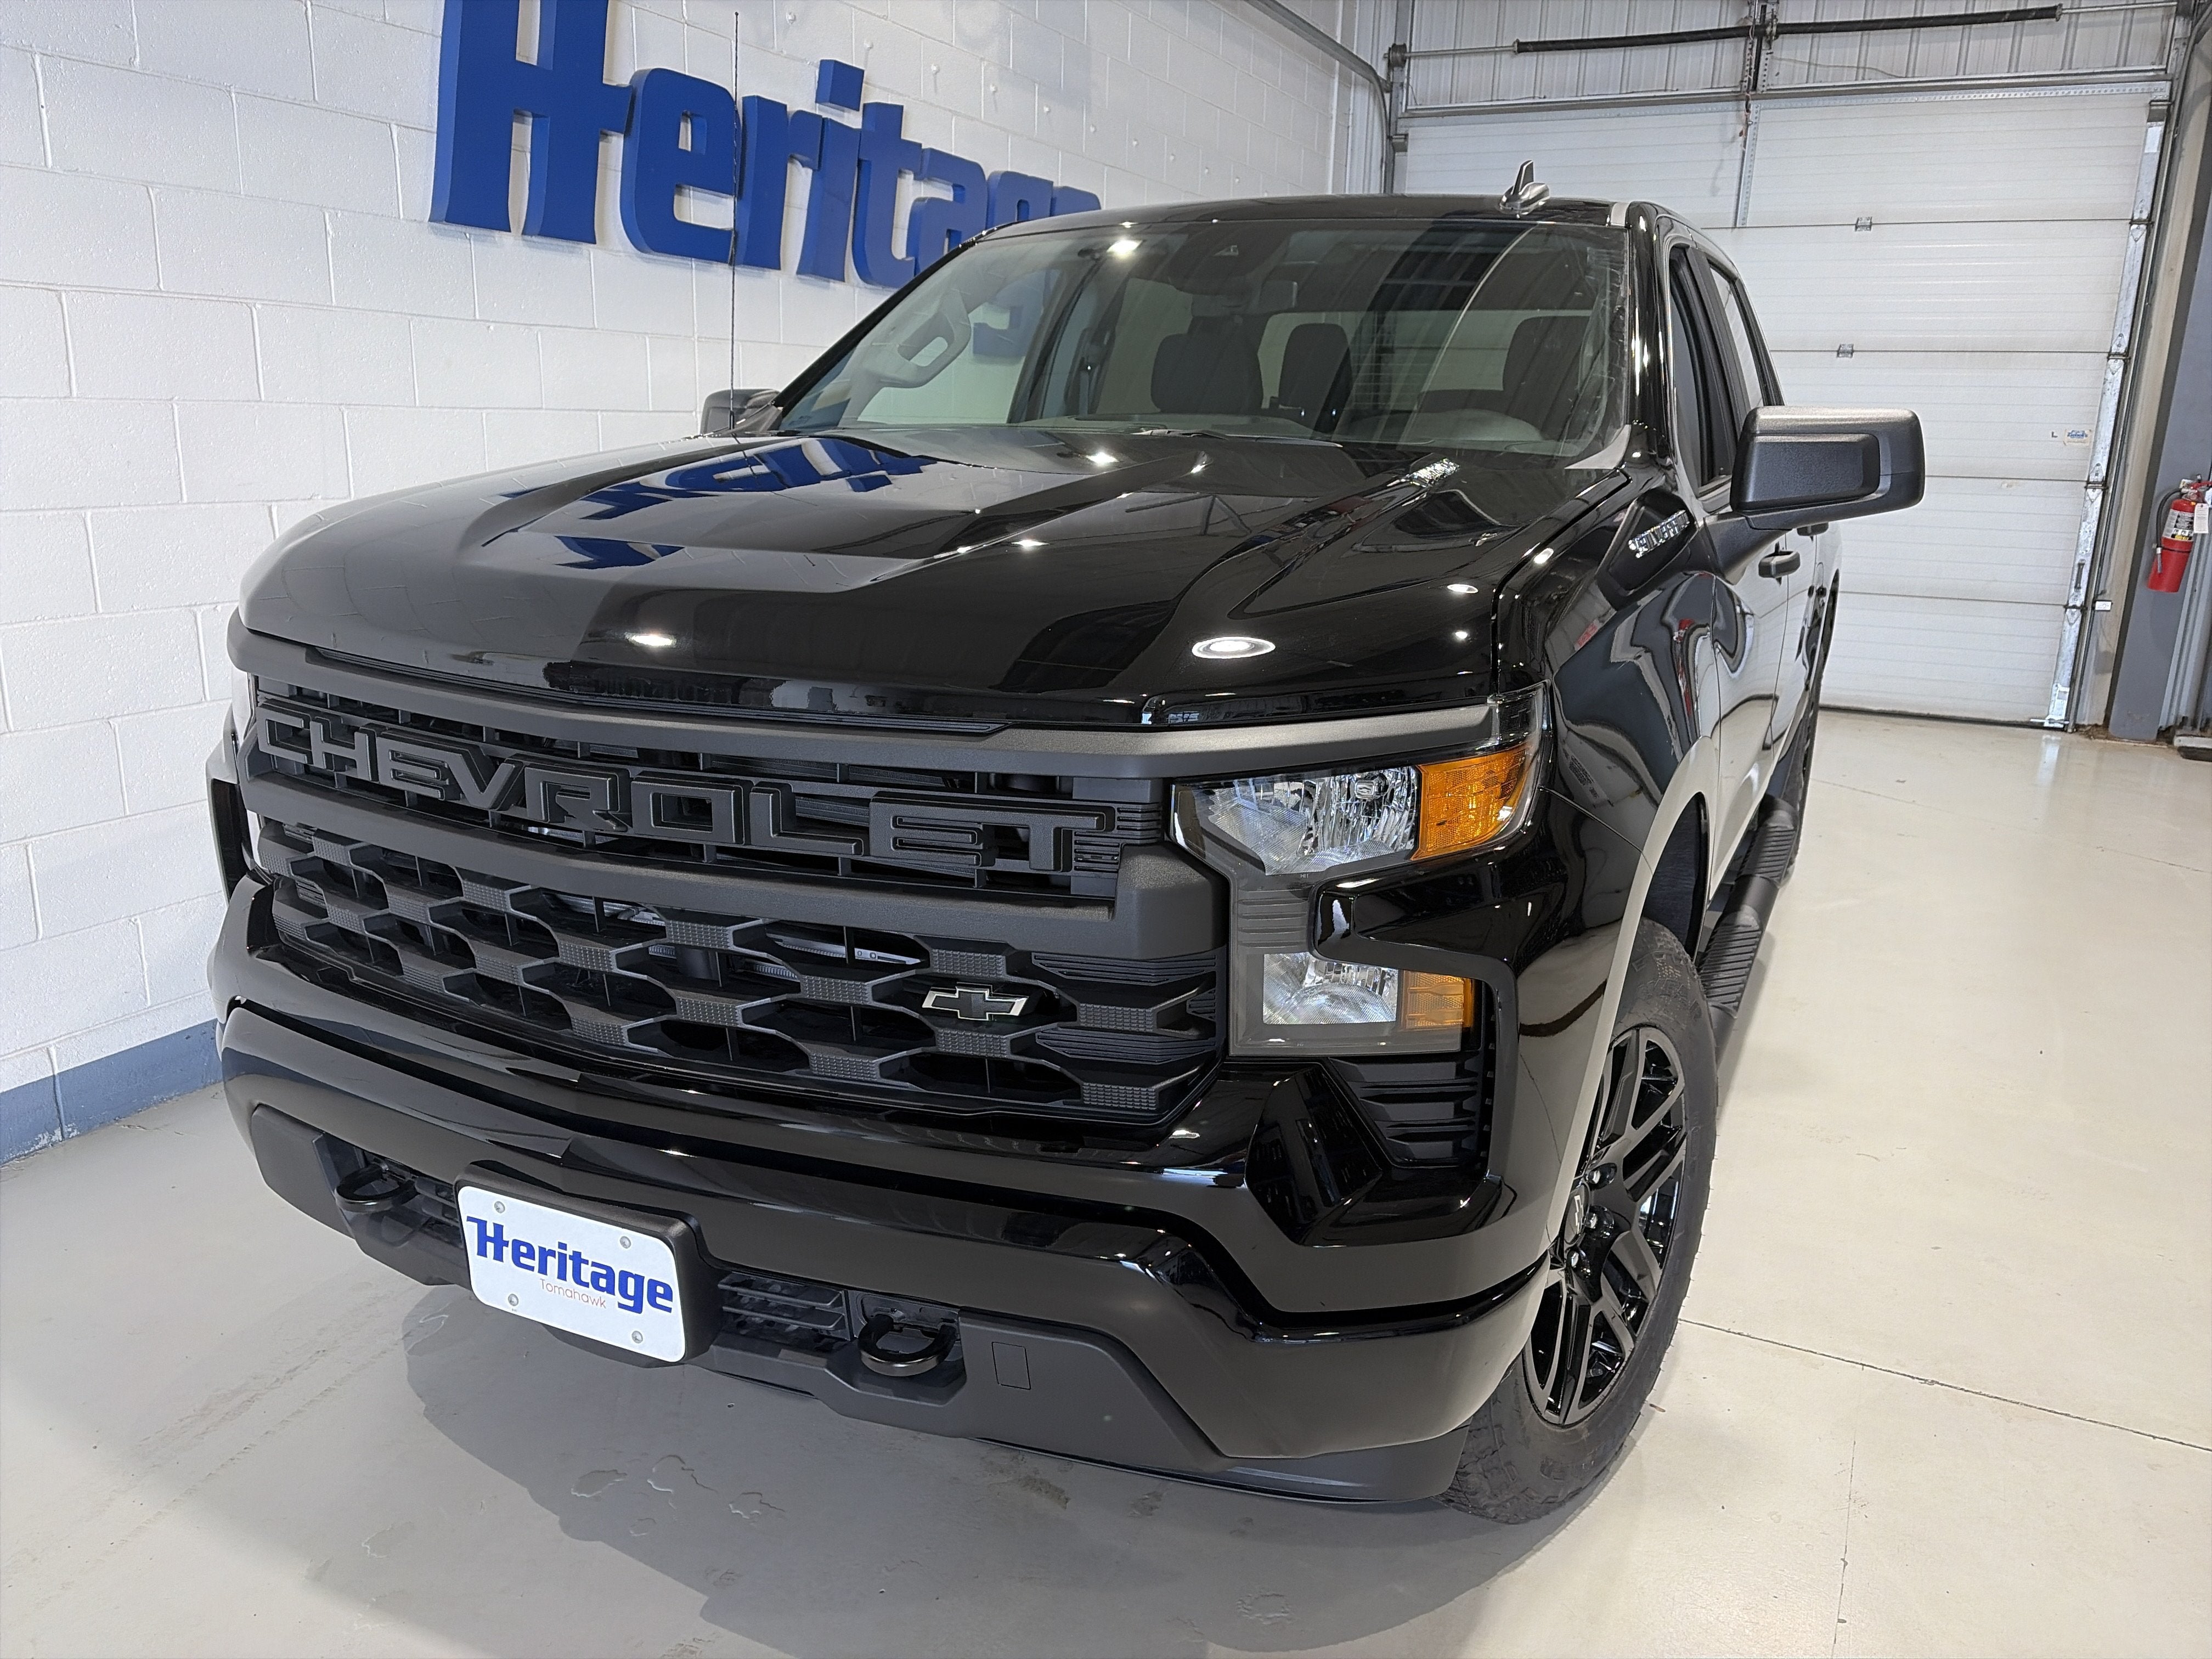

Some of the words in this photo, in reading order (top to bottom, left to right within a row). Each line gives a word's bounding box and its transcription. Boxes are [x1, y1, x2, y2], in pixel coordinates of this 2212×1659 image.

[256, 701, 1114, 872] CHEVROLET
[466, 1216, 673, 1314] Heritage
[540, 1279, 607, 1309] Tomahawk
